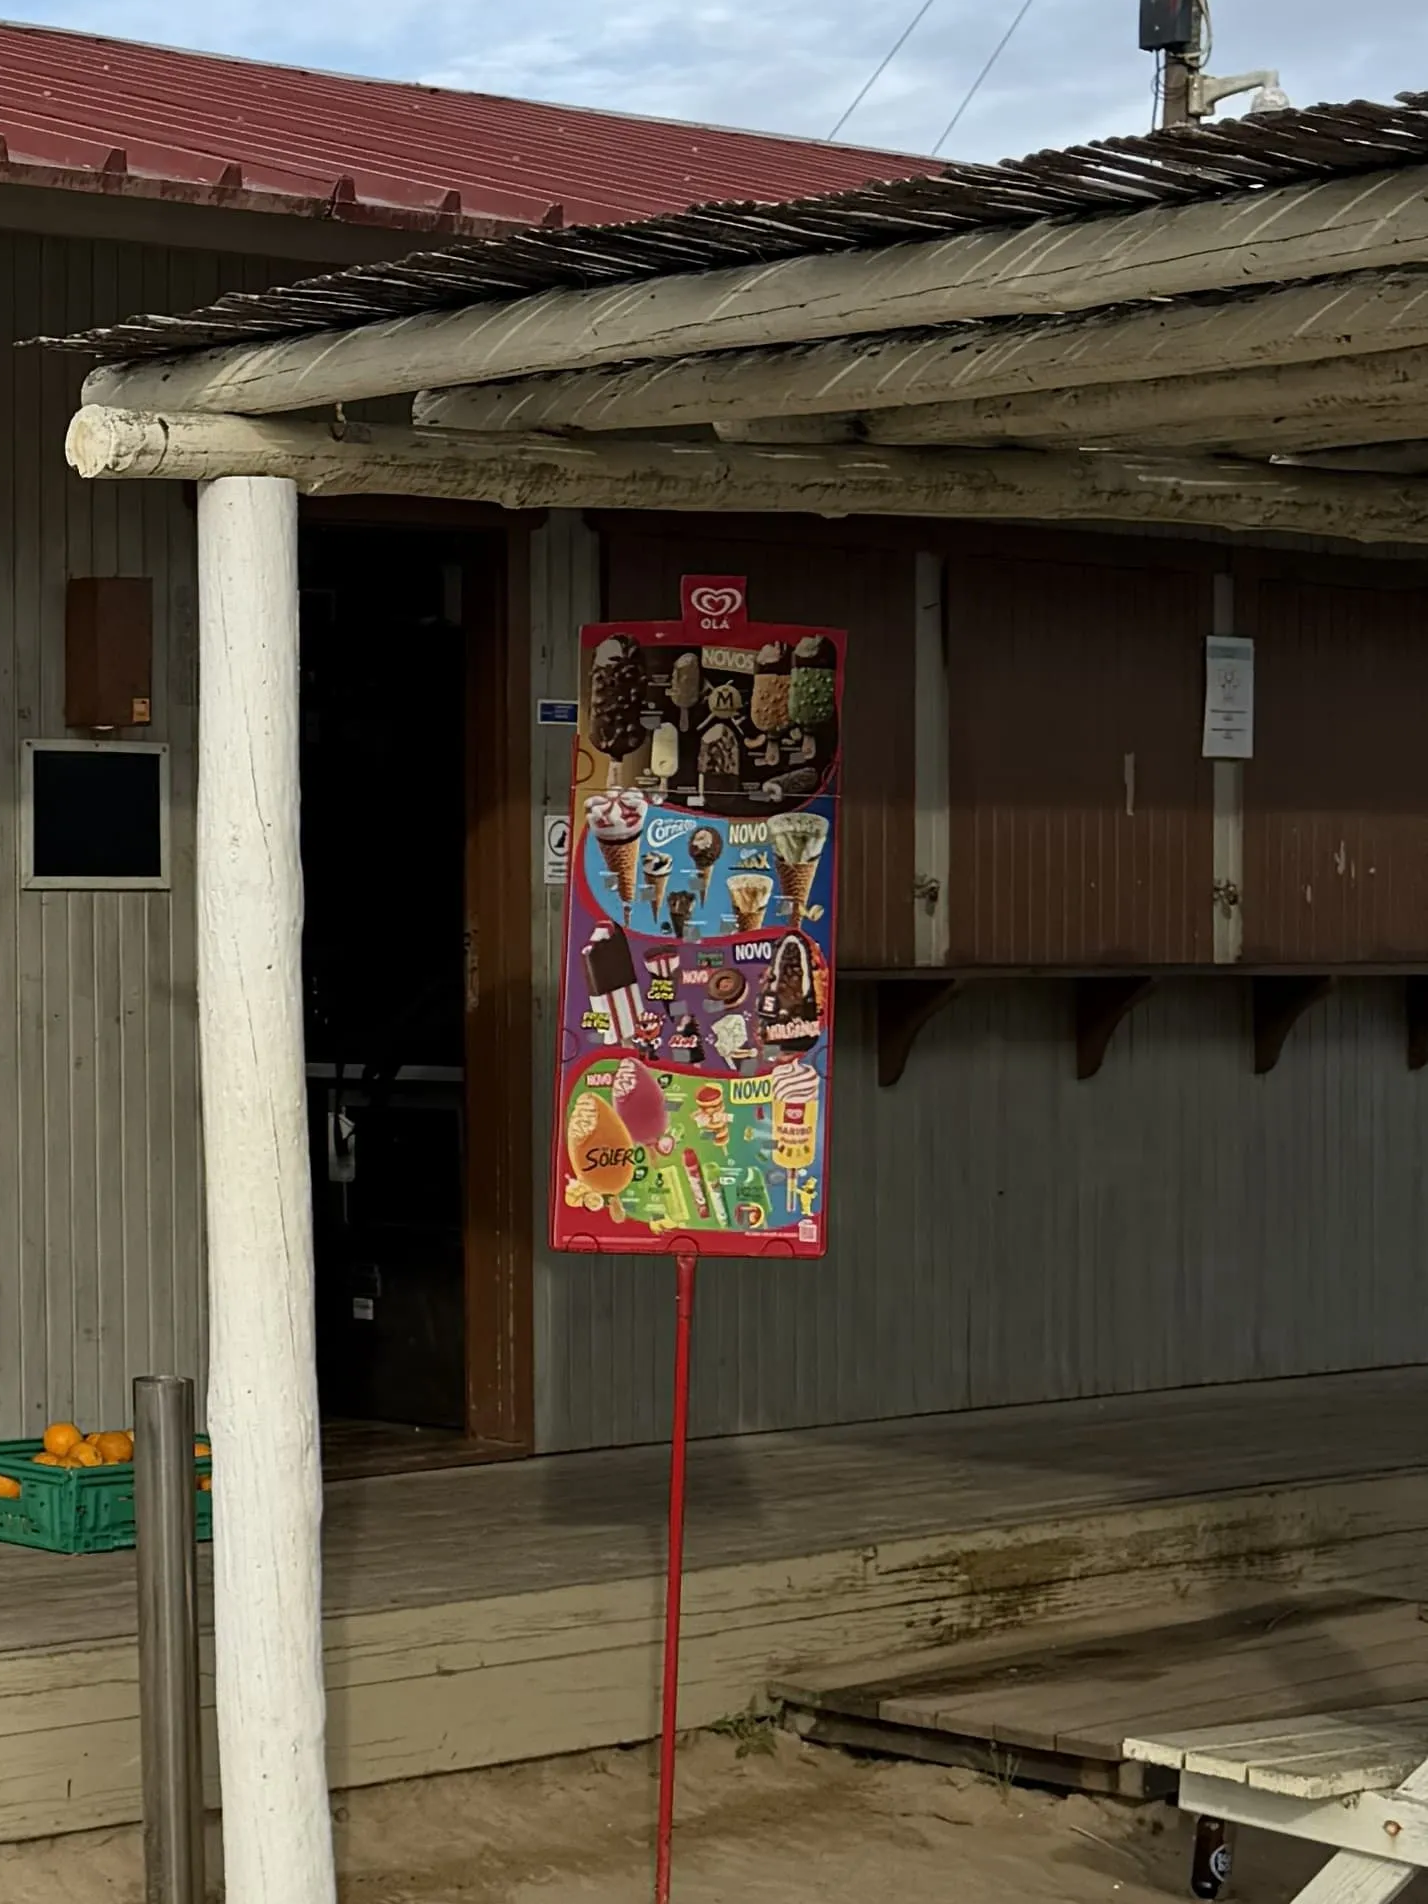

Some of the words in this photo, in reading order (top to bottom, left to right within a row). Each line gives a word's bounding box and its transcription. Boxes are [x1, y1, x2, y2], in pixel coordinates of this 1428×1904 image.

[702, 648, 754, 670] NOVOS
[729, 822, 768, 845] NOVO
[735, 942, 772, 962] NOVO
[682, 969, 709, 984] NOVO
[734, 1079, 771, 1100] NOVO
